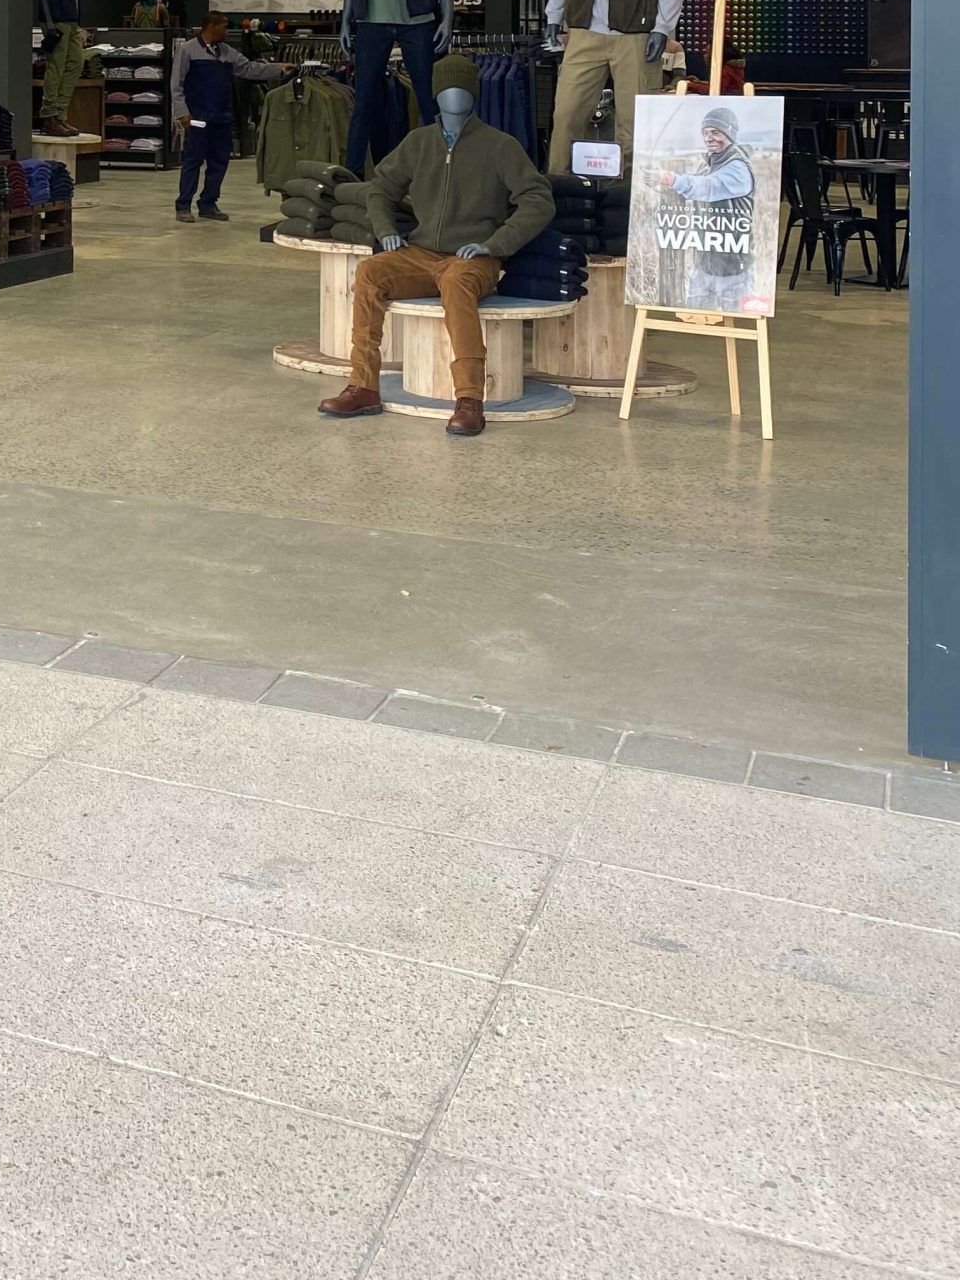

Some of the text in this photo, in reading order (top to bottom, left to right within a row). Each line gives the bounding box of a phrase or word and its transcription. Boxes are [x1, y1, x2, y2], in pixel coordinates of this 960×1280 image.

[701, 207, 751, 215] WORKWEAR
[657, 213, 751, 232] WORKING
[656, 228, 750, 254] WARM
